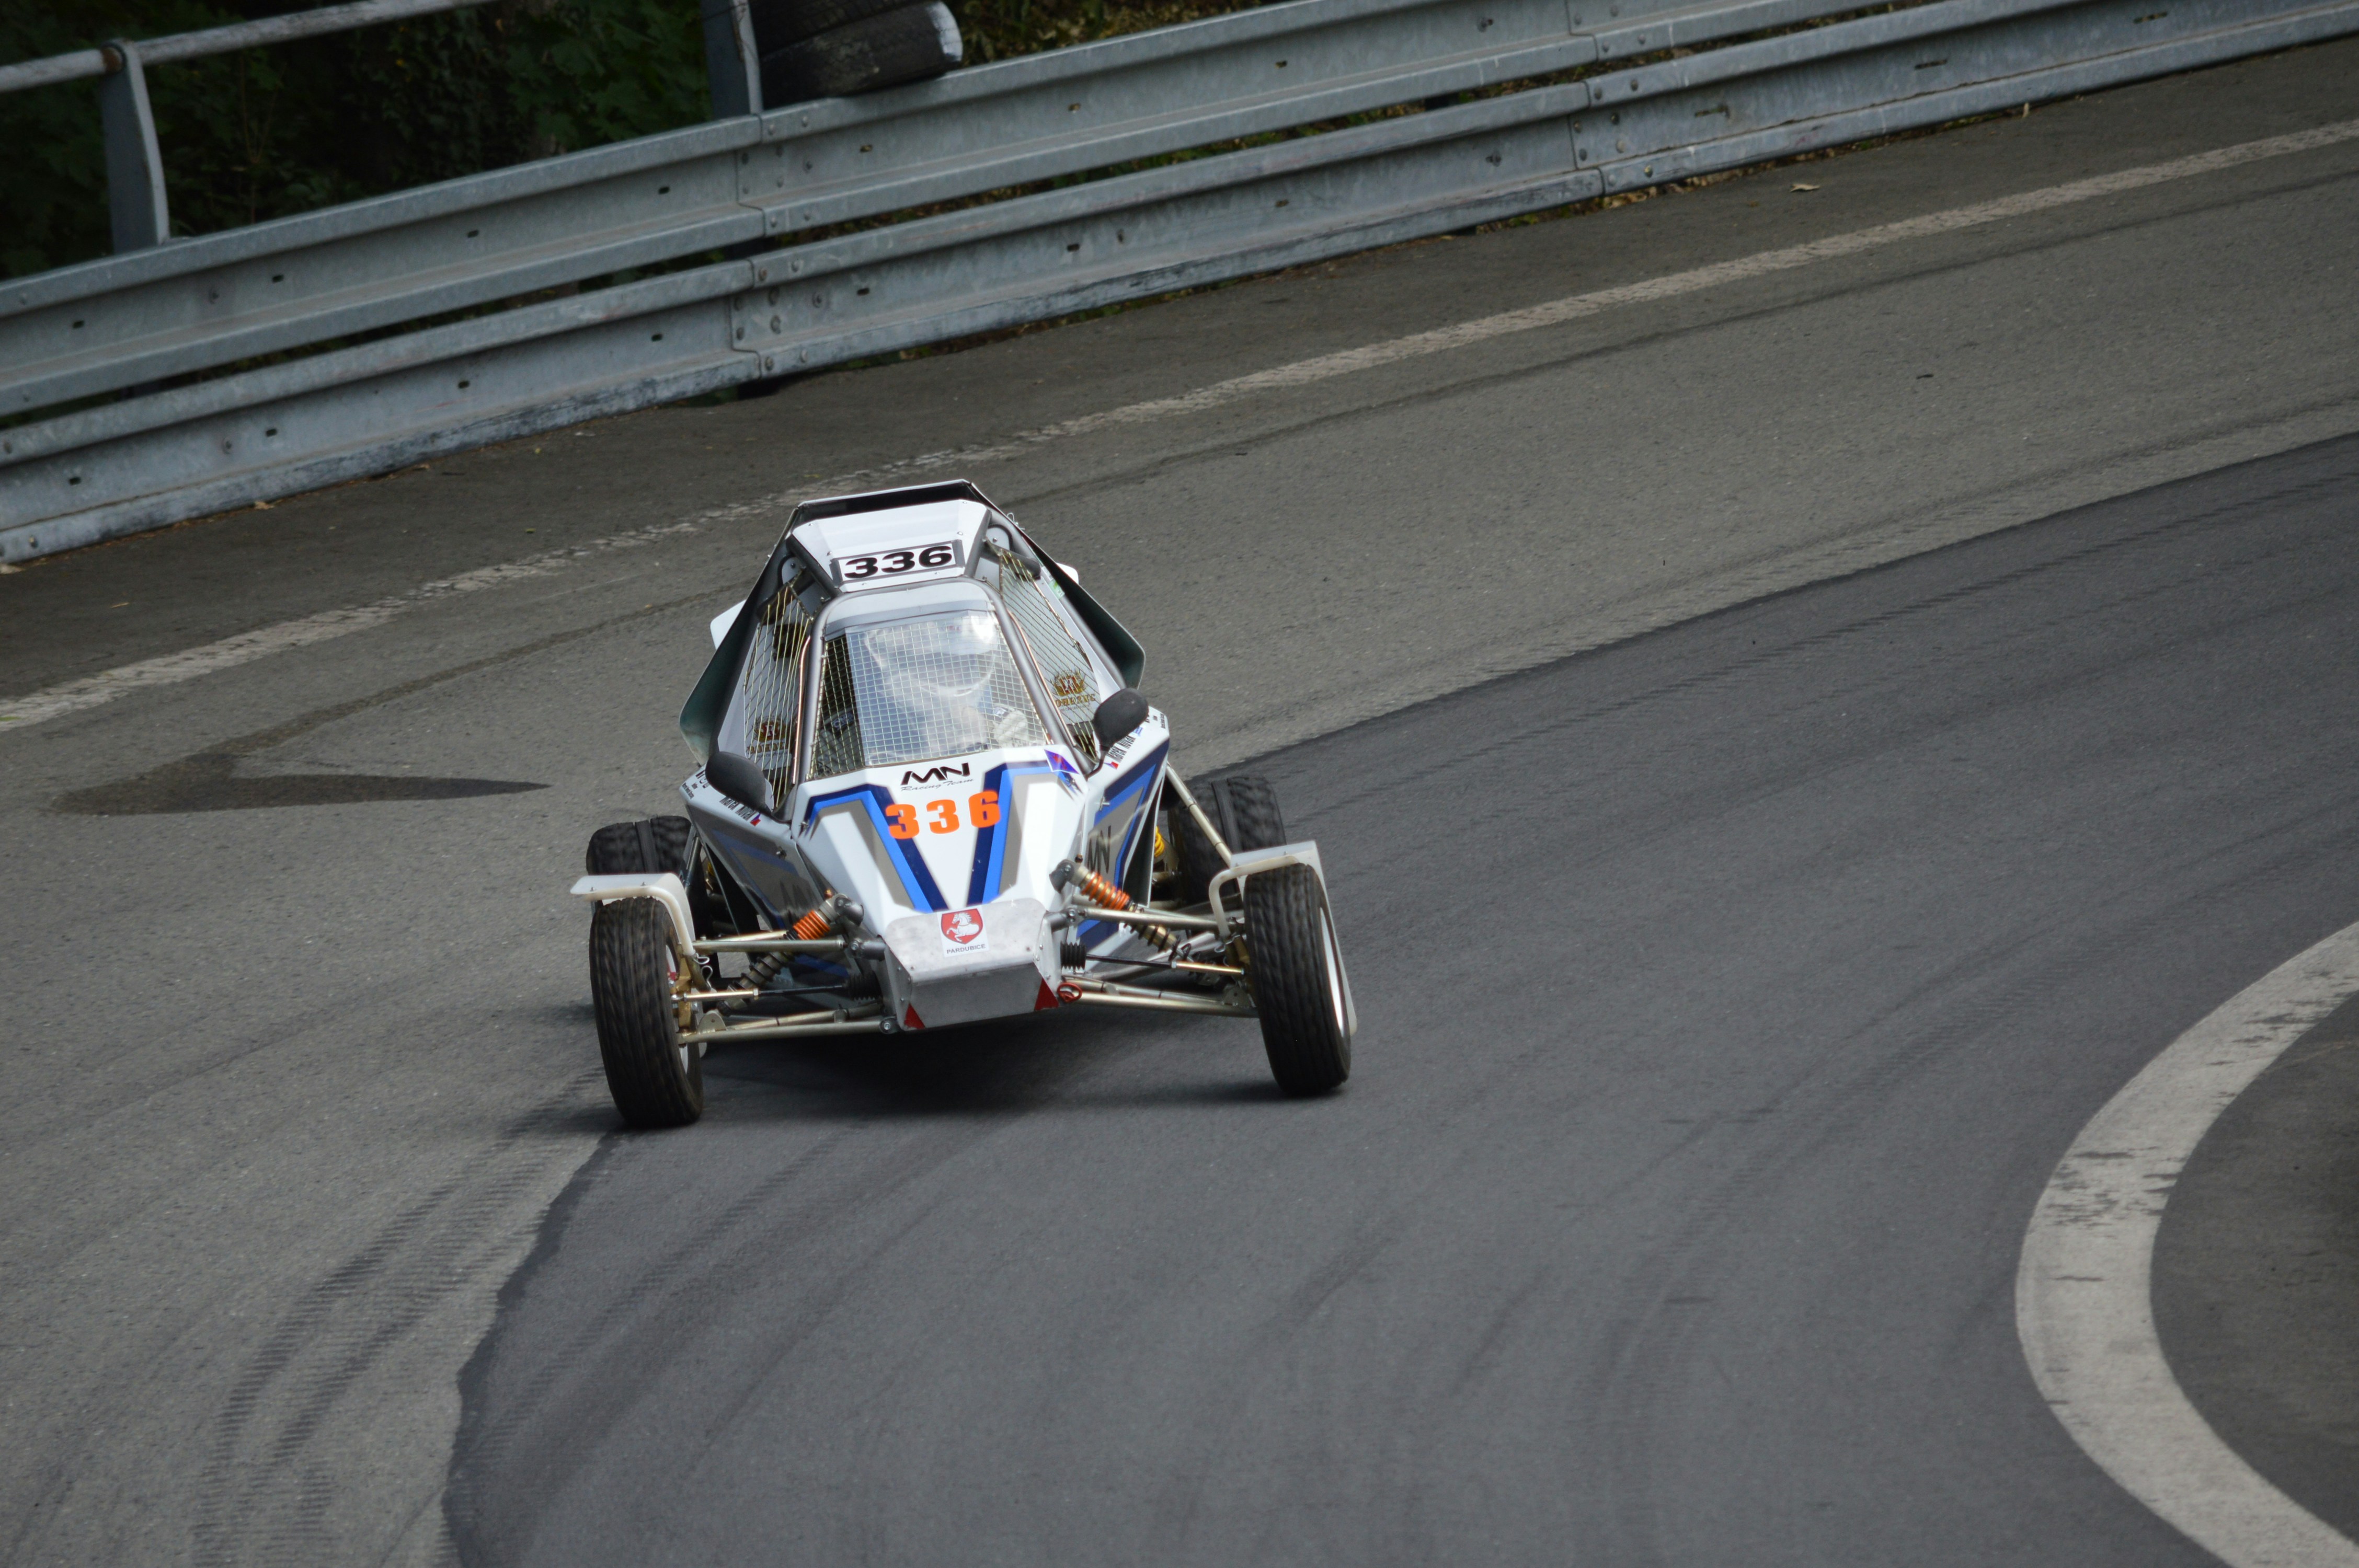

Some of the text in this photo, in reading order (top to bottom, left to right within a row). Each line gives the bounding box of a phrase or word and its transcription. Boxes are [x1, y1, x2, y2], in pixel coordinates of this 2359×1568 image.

[844, 545, 953, 579] 336
[900, 762, 970, 786] MN
[900, 783, 942, 792] Racing
[885, 790, 1001, 839] 336
[946, 943, 986, 954] PARDUBICE
